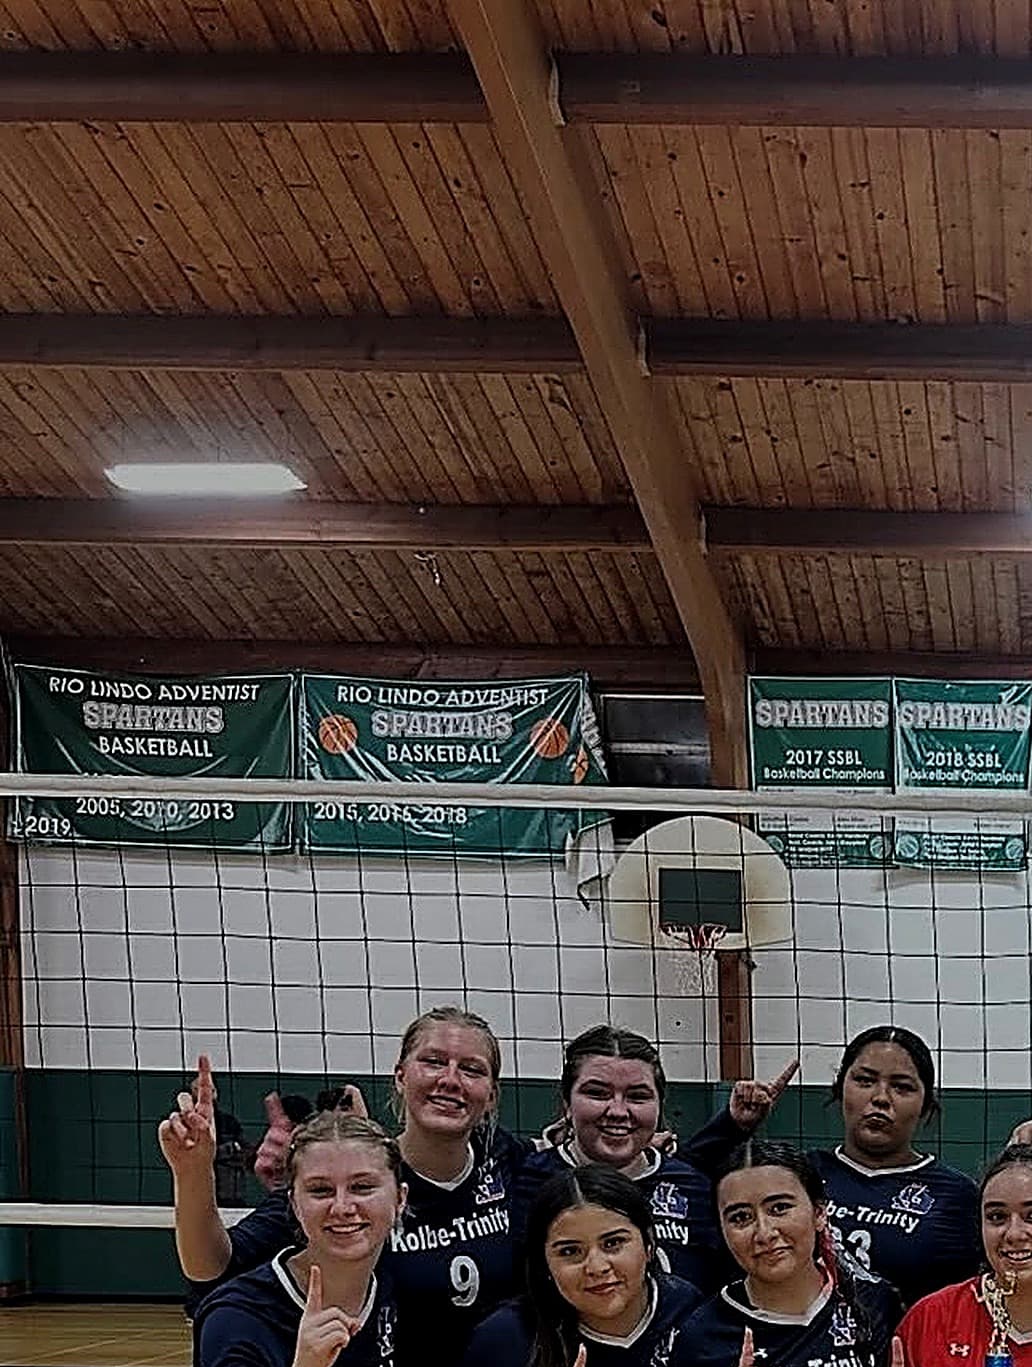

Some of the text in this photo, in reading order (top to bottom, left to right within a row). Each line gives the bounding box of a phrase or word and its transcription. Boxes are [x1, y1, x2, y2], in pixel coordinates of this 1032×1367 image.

[50, 677, 260, 701] RIO LINDO ADVENTIST
[337, 685, 549, 706] RIO LINDO ADVENTIST
[82, 701, 224, 733] SPARTANS
[755, 699, 890, 729] SPARTANS
[900, 702, 1029, 731] SPARTANS
[371, 709, 514, 741] SPARTANS
[99, 736, 213, 757] BASKETBALL
[387, 743, 502, 764] BASKETBALL
[786, 750, 862, 765] 2017 SSBL
[926, 751, 1003, 768] 2018 SSBL
[763, 767, 885, 783] Basketball Champions
[961, 769, 1024, 784] Champions
[76, 798, 125, 818] 2005,
[189, 803, 234, 820] 2013
[314, 802, 363, 822] 2015,
[391, 1206, 510, 1252] Kolbe-Trinity
[450, 1255, 480, 1307] 9
